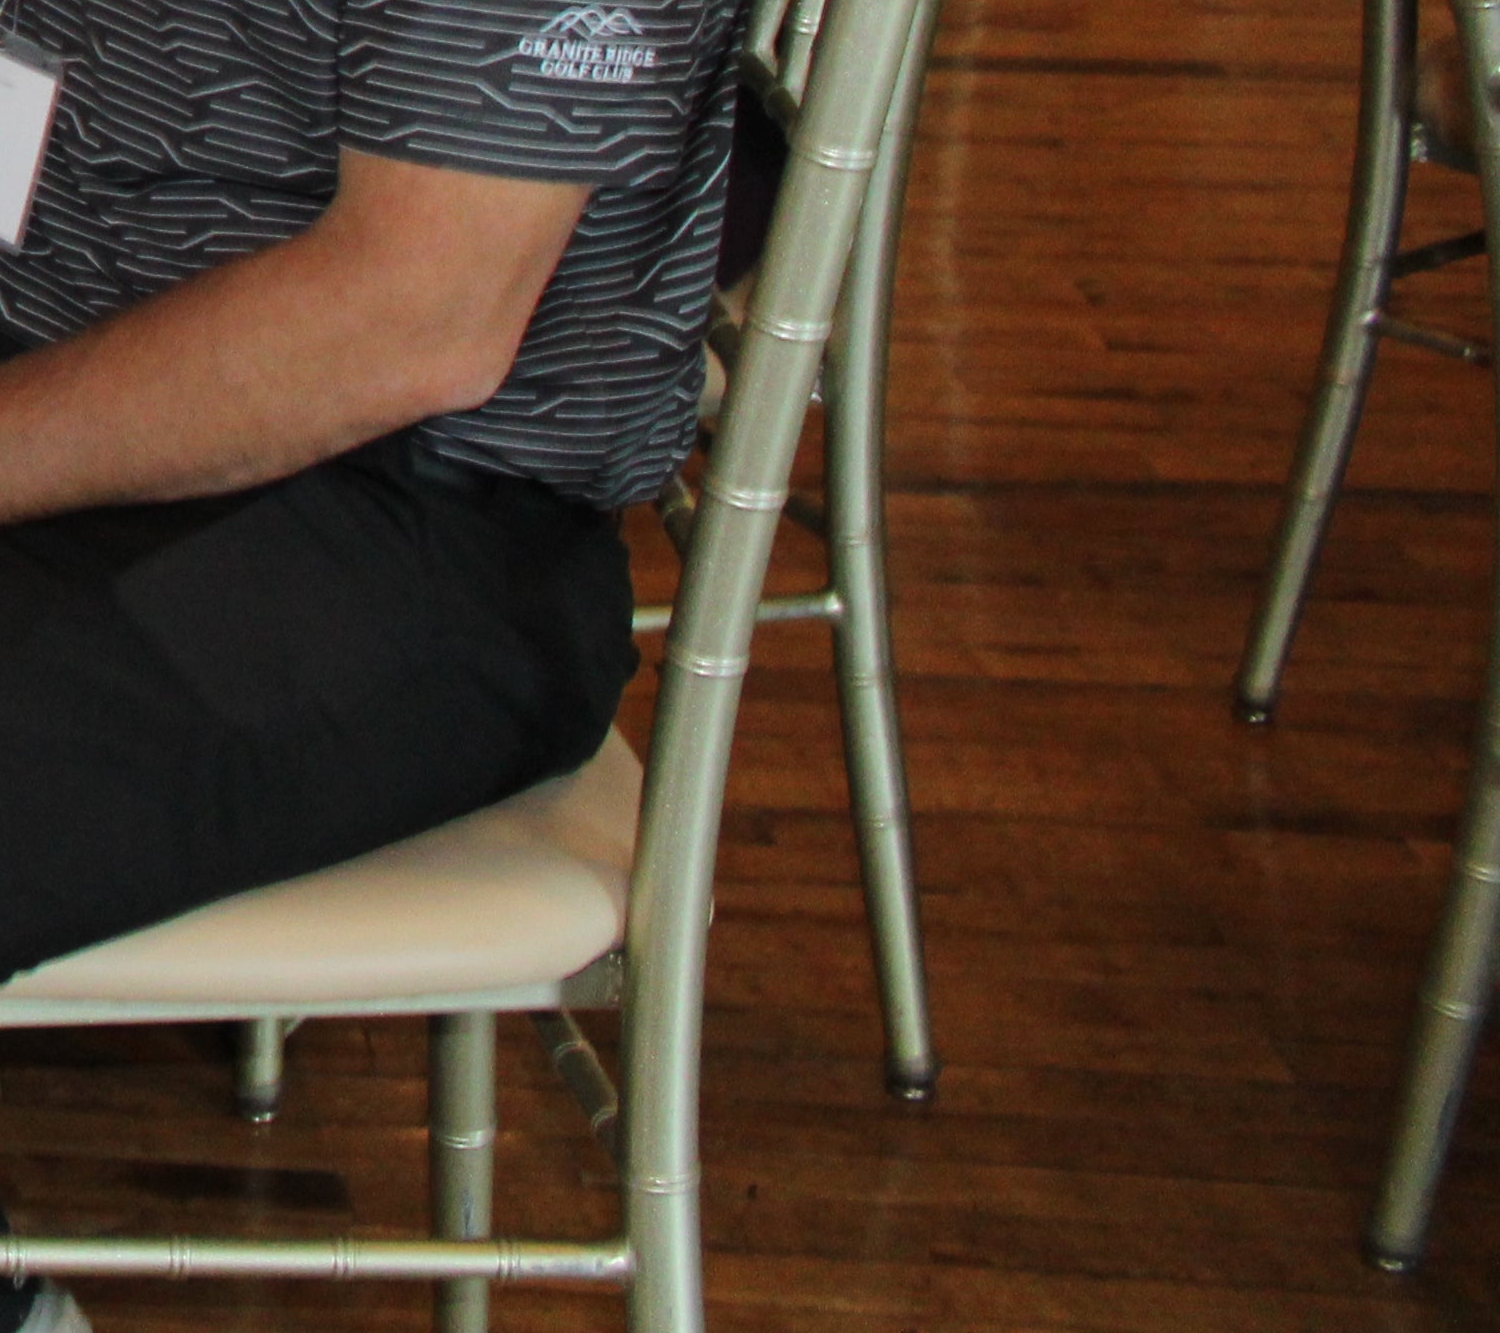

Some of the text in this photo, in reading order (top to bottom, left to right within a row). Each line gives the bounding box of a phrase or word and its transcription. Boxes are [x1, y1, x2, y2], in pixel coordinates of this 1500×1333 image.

[518, 35, 657, 68] GRANITE RIDGE
[540, 58, 634, 84] GOLF CLUB
